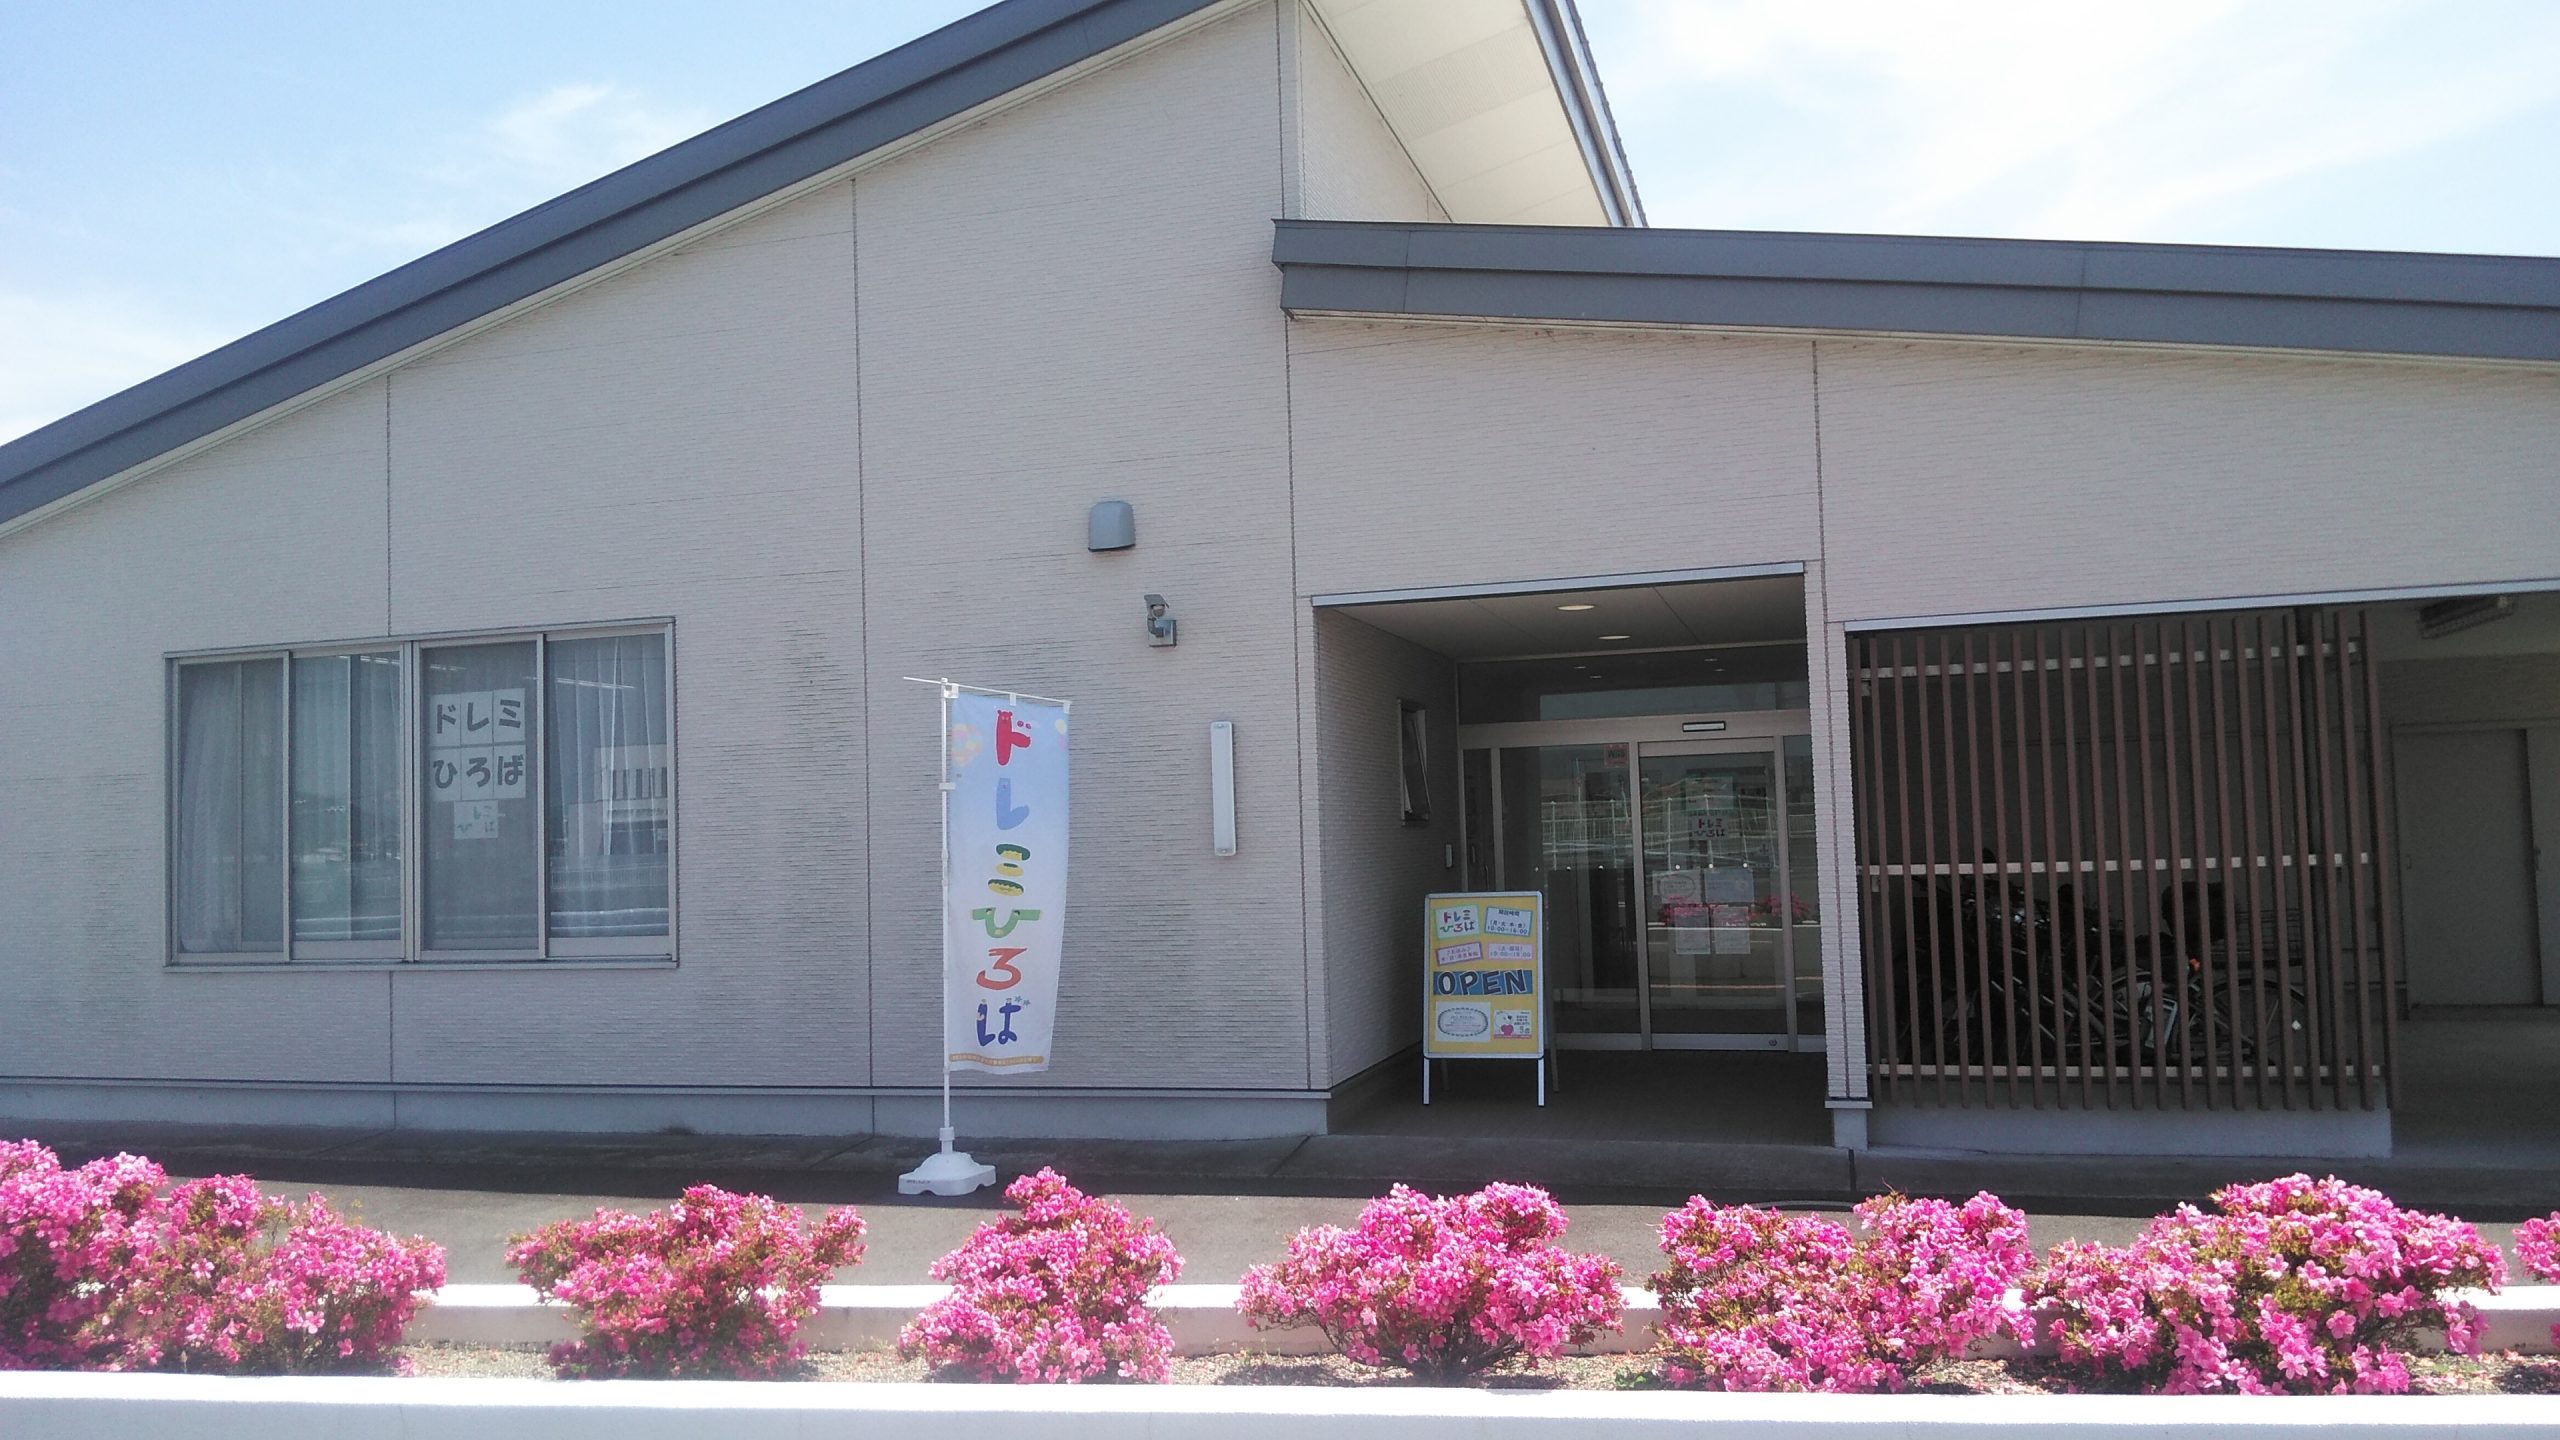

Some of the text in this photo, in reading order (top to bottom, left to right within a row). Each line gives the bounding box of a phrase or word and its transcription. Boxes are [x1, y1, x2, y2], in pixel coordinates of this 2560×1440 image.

[436, 699, 521, 734] ドレミ
[433, 754, 524, 789] ひろば
[972, 710, 1041, 1046] ドレミひろば
[1438, 969, 1527, 995] OPEN
